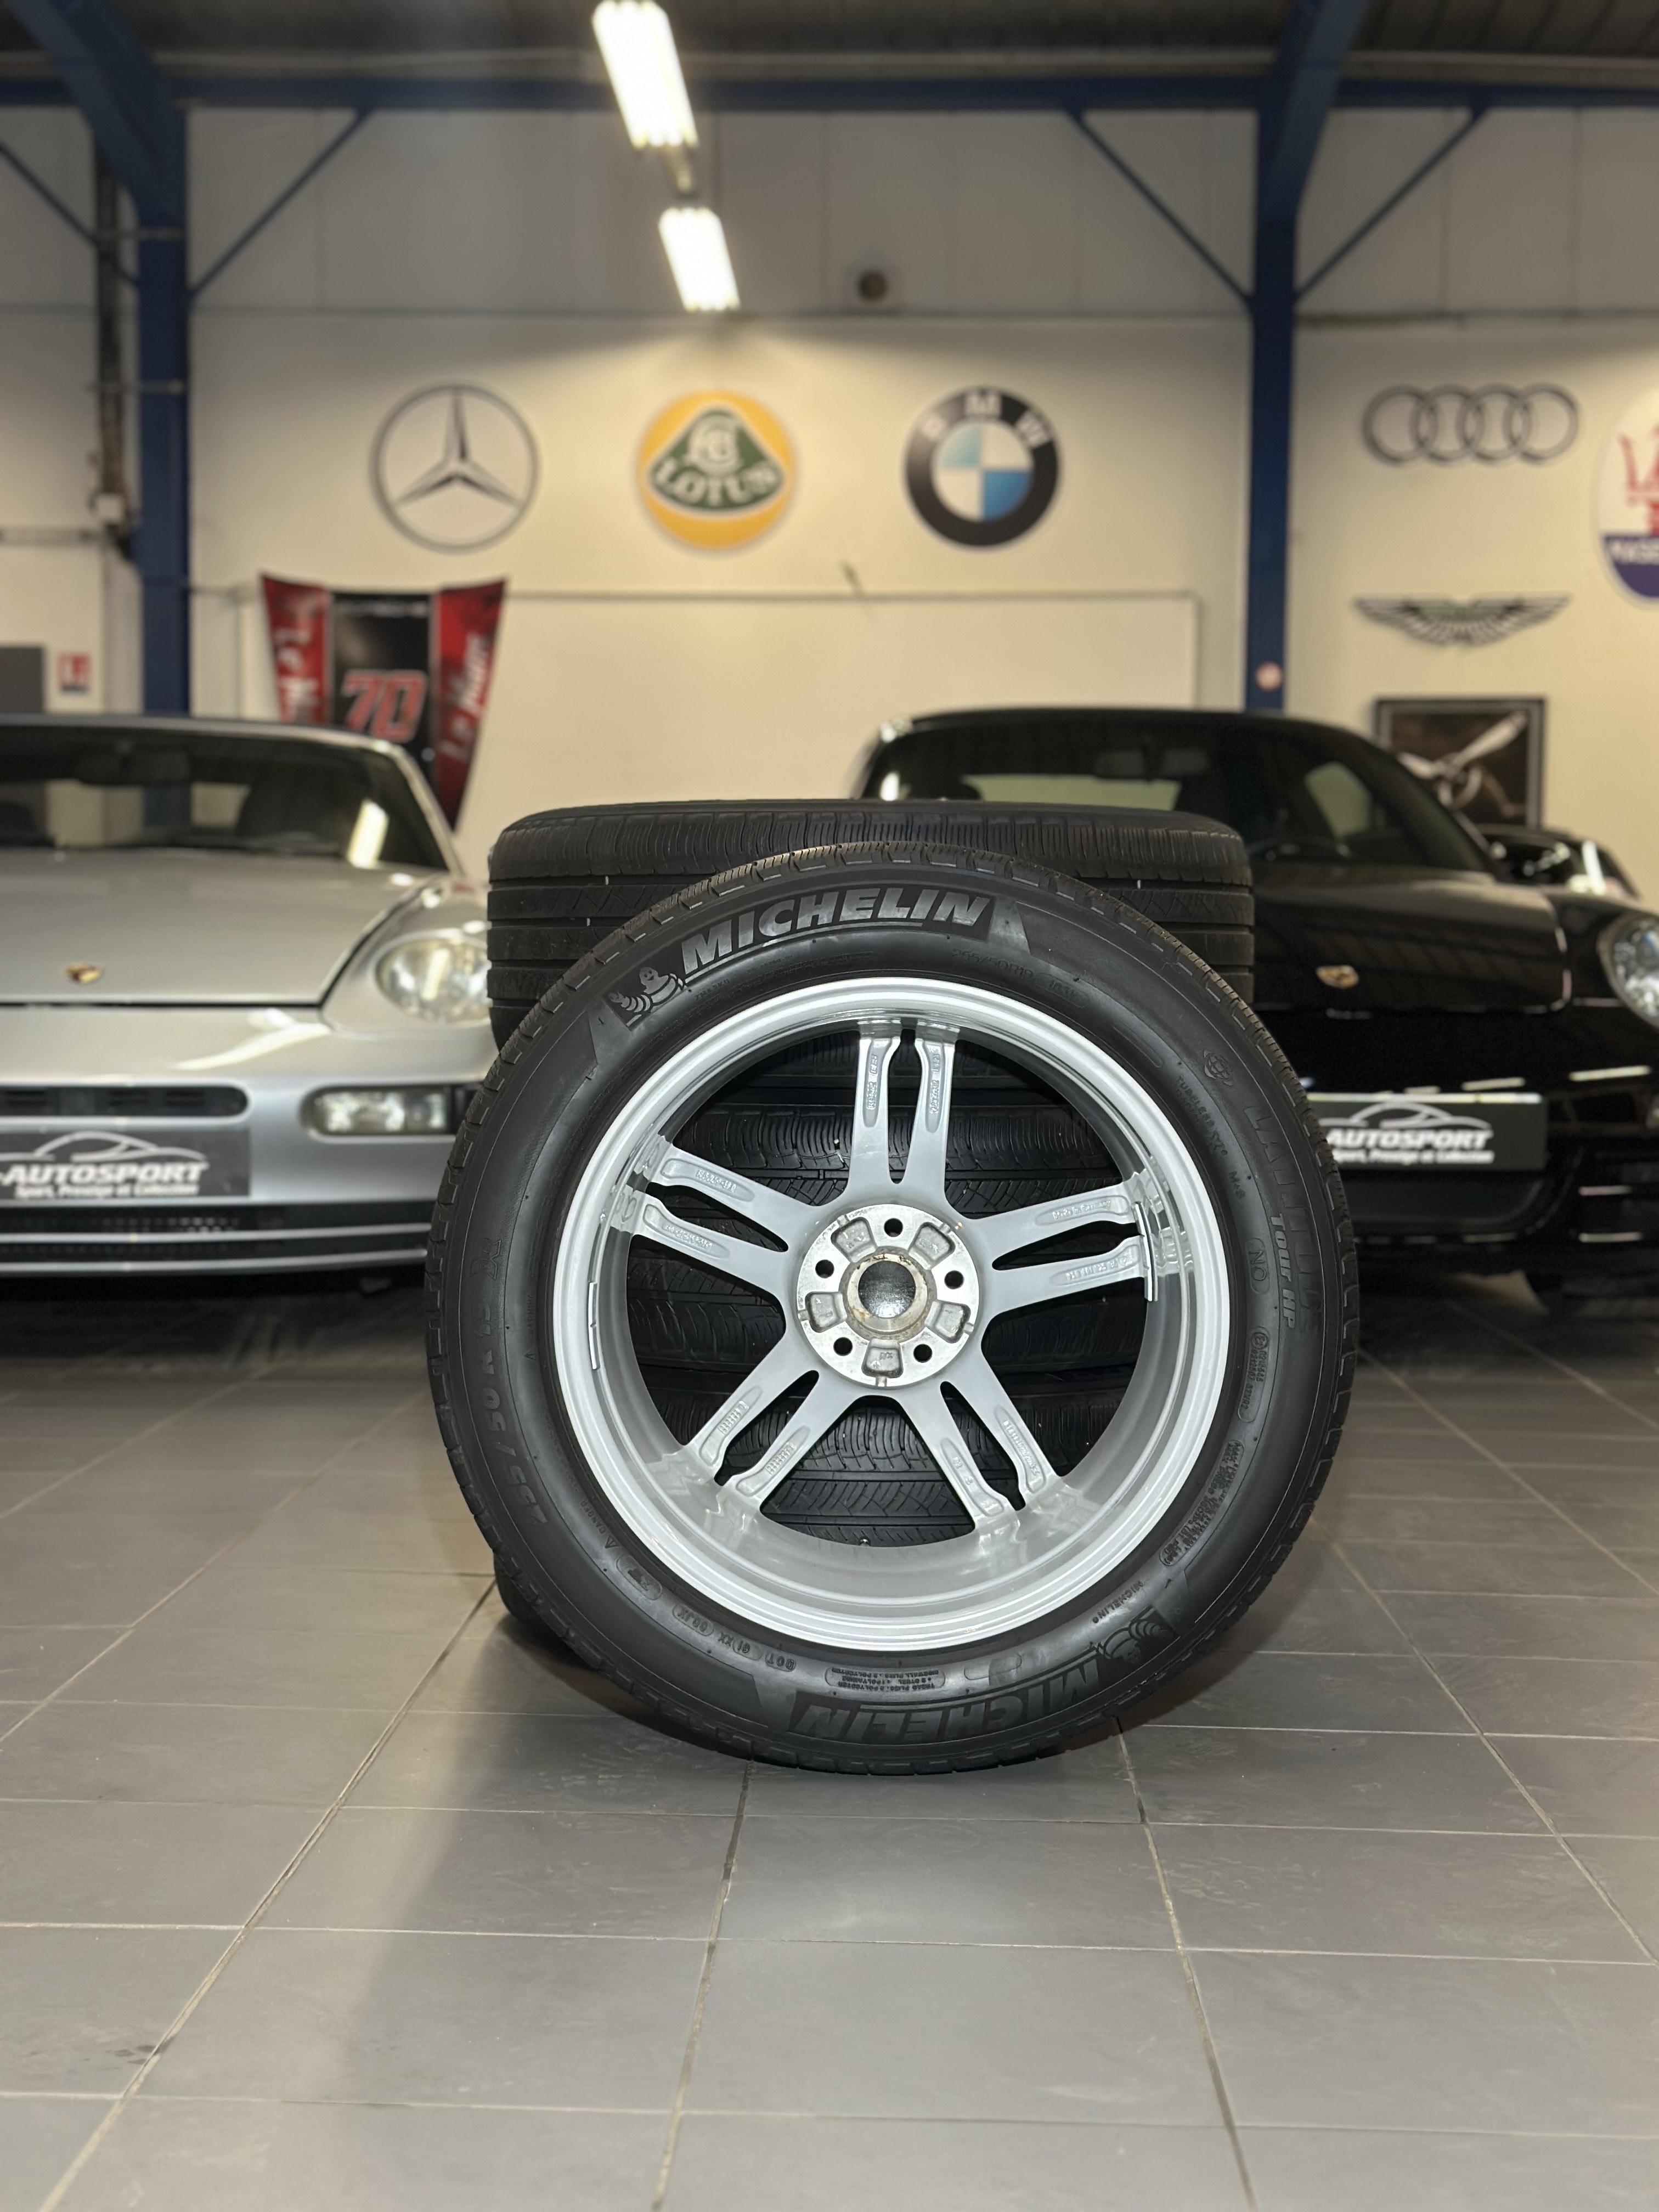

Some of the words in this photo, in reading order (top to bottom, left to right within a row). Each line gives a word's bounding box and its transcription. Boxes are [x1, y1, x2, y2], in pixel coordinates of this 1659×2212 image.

[922, 390, 1050, 448] BMW
[654, 458, 778, 506] LOTUS
[342, 670, 427, 743] 70
[682, 887, 990, 975] MICHELIN
[1327, 1129, 1494, 1149] AUTOSPORT
[2, 1163, 210, 1186] AUTOSPORT
[1271, 1213, 1291, 1282] Tour
[1282, 1288, 1296, 1329] HP
[767, 1652, 797, 1671] DOT
[795, 1658, 1100, 1742] MICHELIN
